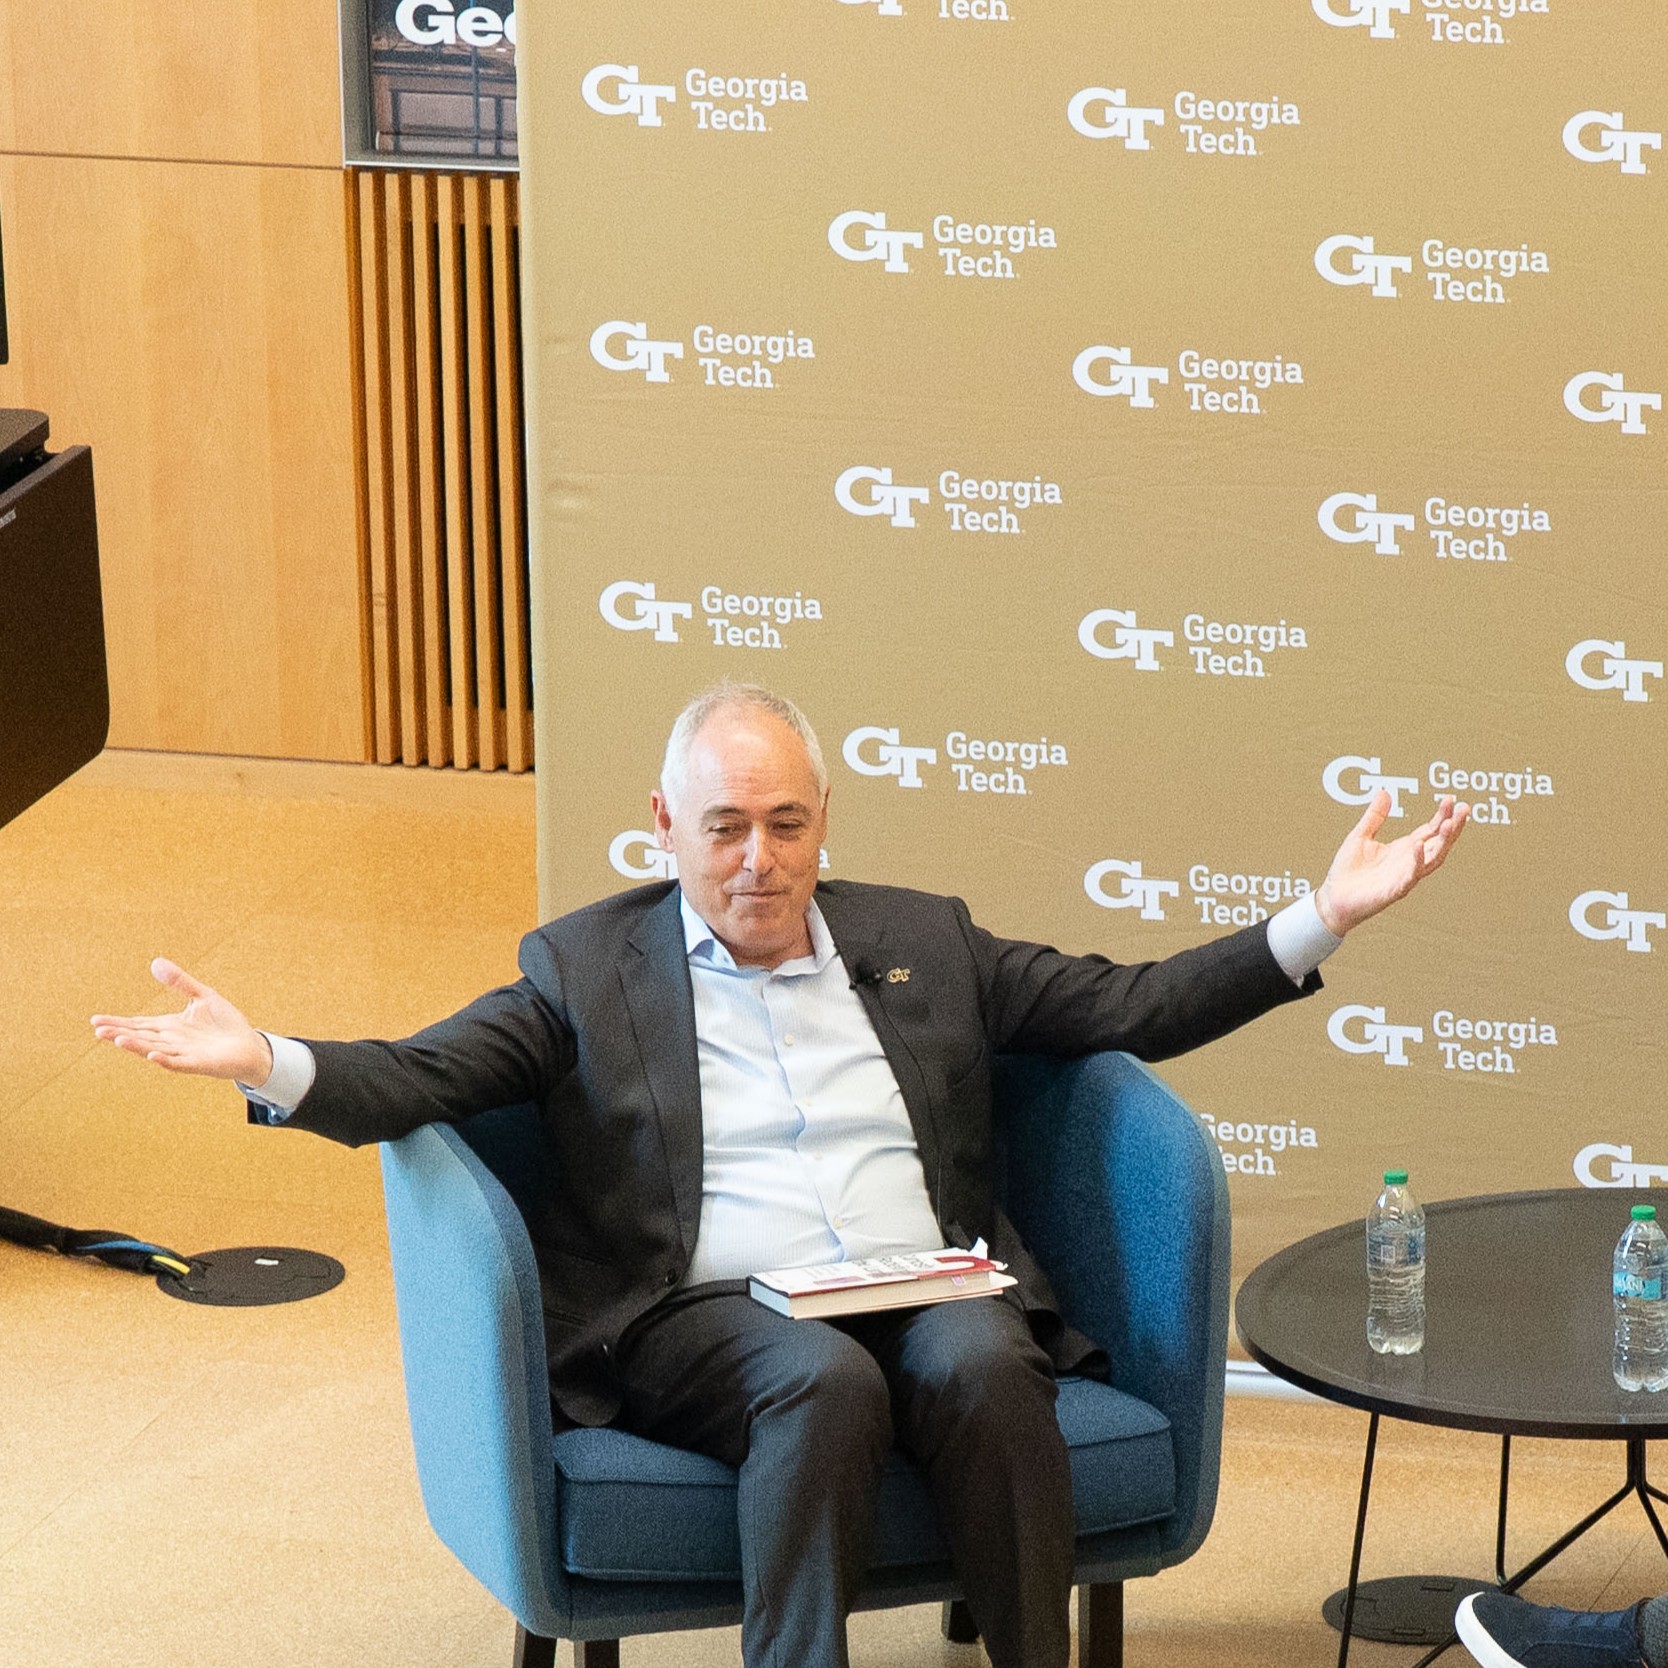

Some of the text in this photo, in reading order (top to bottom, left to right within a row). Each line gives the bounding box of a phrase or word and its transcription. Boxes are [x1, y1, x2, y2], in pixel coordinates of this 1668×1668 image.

[1421, 0, 1549, 18] rgia
[1425, 13, 1504, 44] Tech
[581, 63, 676, 128] GT
[685, 68, 807, 106] Georgia
[690, 101, 765, 132] Tech
[1066, 87, 1165, 151] GT
[1174, 91, 1300, 130] Georgia
[1179, 124, 1256, 155] Tech
[1562, 110, 1662, 175] GT
[827, 210, 924, 273] GT
[933, 215, 1056, 253] Georgia
[938, 248, 1014, 278] Tech
[1313, 234, 1412, 298] GT
[1422, 240, 1549, 277] Georgia
[1427, 272, 1504, 303] Tech
[589, 320, 684, 383] GT
[693, 325, 814, 363] Georgia
[699, 358, 773, 388] Tech
[1072, 345, 1169, 408] GT
[1178, 350, 1302, 388] Georgia
[1184, 382, 1260, 414] Tech
[1563, 371, 1662, 434] GT
[834, 465, 930, 528] GT
[939, 470, 1061, 509] Georgia
[944, 503, 1020, 533] Tech
[1317, 492, 1415, 555] GT
[1425, 497, 1551, 536] Georgia
[1429, 529, 1507, 561] Tech
[598, 580, 693, 643] GT
[701, 585, 822, 624] Georgia
[707, 618, 781, 648] Tech
[1078, 608, 1174, 671] GT
[1184, 614, 1307, 652] Georgia
[1189, 646, 1264, 677] Tech
[1565, 639, 1663, 702] GT
[842, 726, 937, 788] GT
[946, 731, 1067, 770] Georgia
[951, 764, 1026, 794] Tech
[1322, 755, 1419, 817] GT
[1428, 761, 1553, 800] Georgia
[1434, 793, 1511, 824] ch
[1084, 859, 1179, 920] GT
[1189, 865, 1312, 902] Georgia
[1194, 896, 1268, 926] Tech
[1569, 891, 1666, 952] GT
[1327, 1004, 1423, 1066] GT
[1432, 1010, 1557, 1049] Georgia
[1438, 1041, 1513, 1073] Tech
[1217, 1145, 1276, 1175] ech
